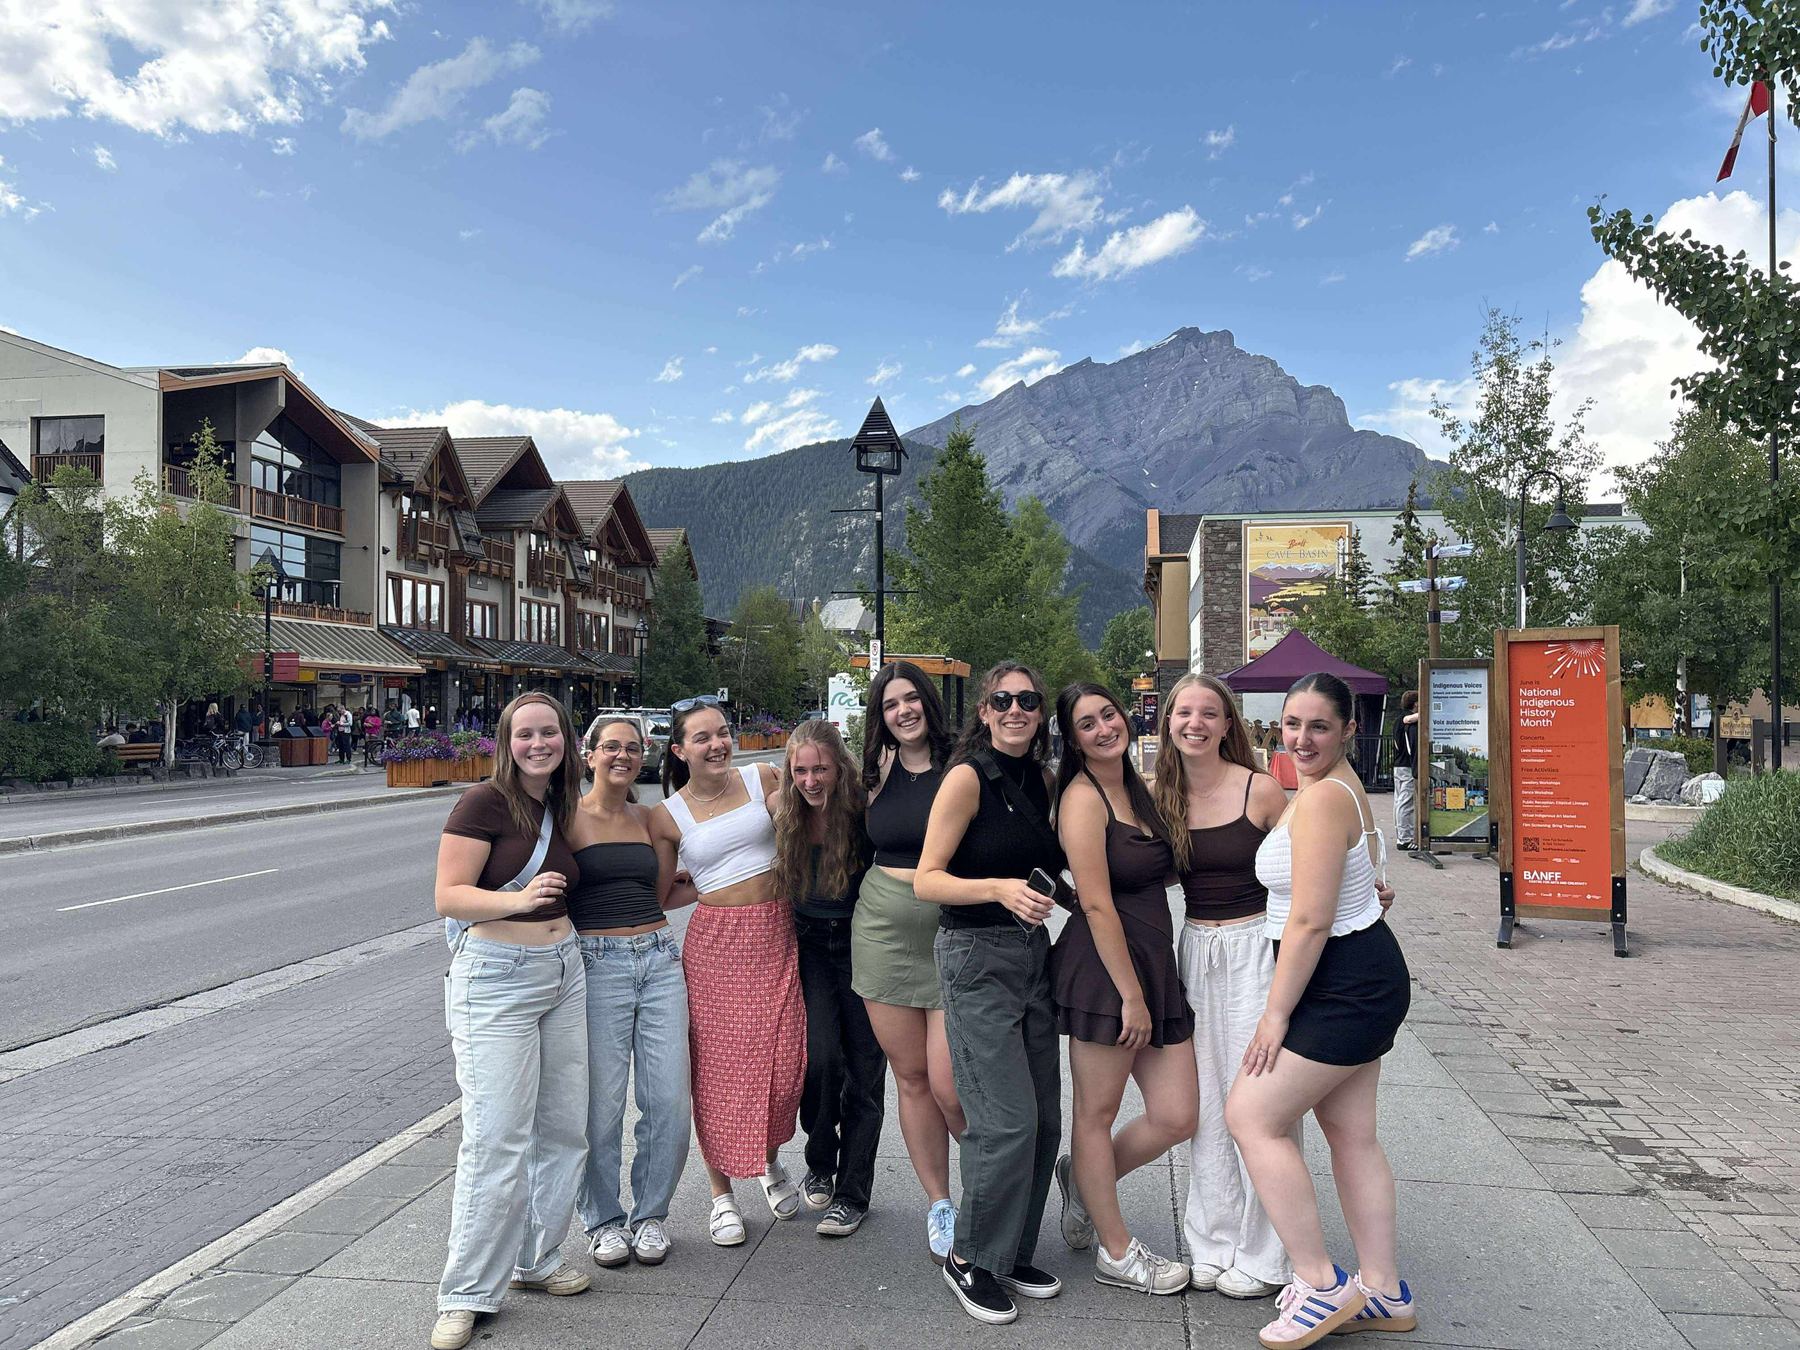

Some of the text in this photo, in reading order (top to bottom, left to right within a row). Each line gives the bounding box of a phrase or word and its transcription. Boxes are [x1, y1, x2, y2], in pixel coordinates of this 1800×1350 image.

[1266, 550, 1328, 559] CAVE BASIN
[1520, 688, 1560, 696] National
[1520, 699, 1575, 708] Indigenous
[1520, 708, 1556, 718] History
[1520, 719, 1552, 727] Month
[1524, 870, 1561, 880] BANFF
